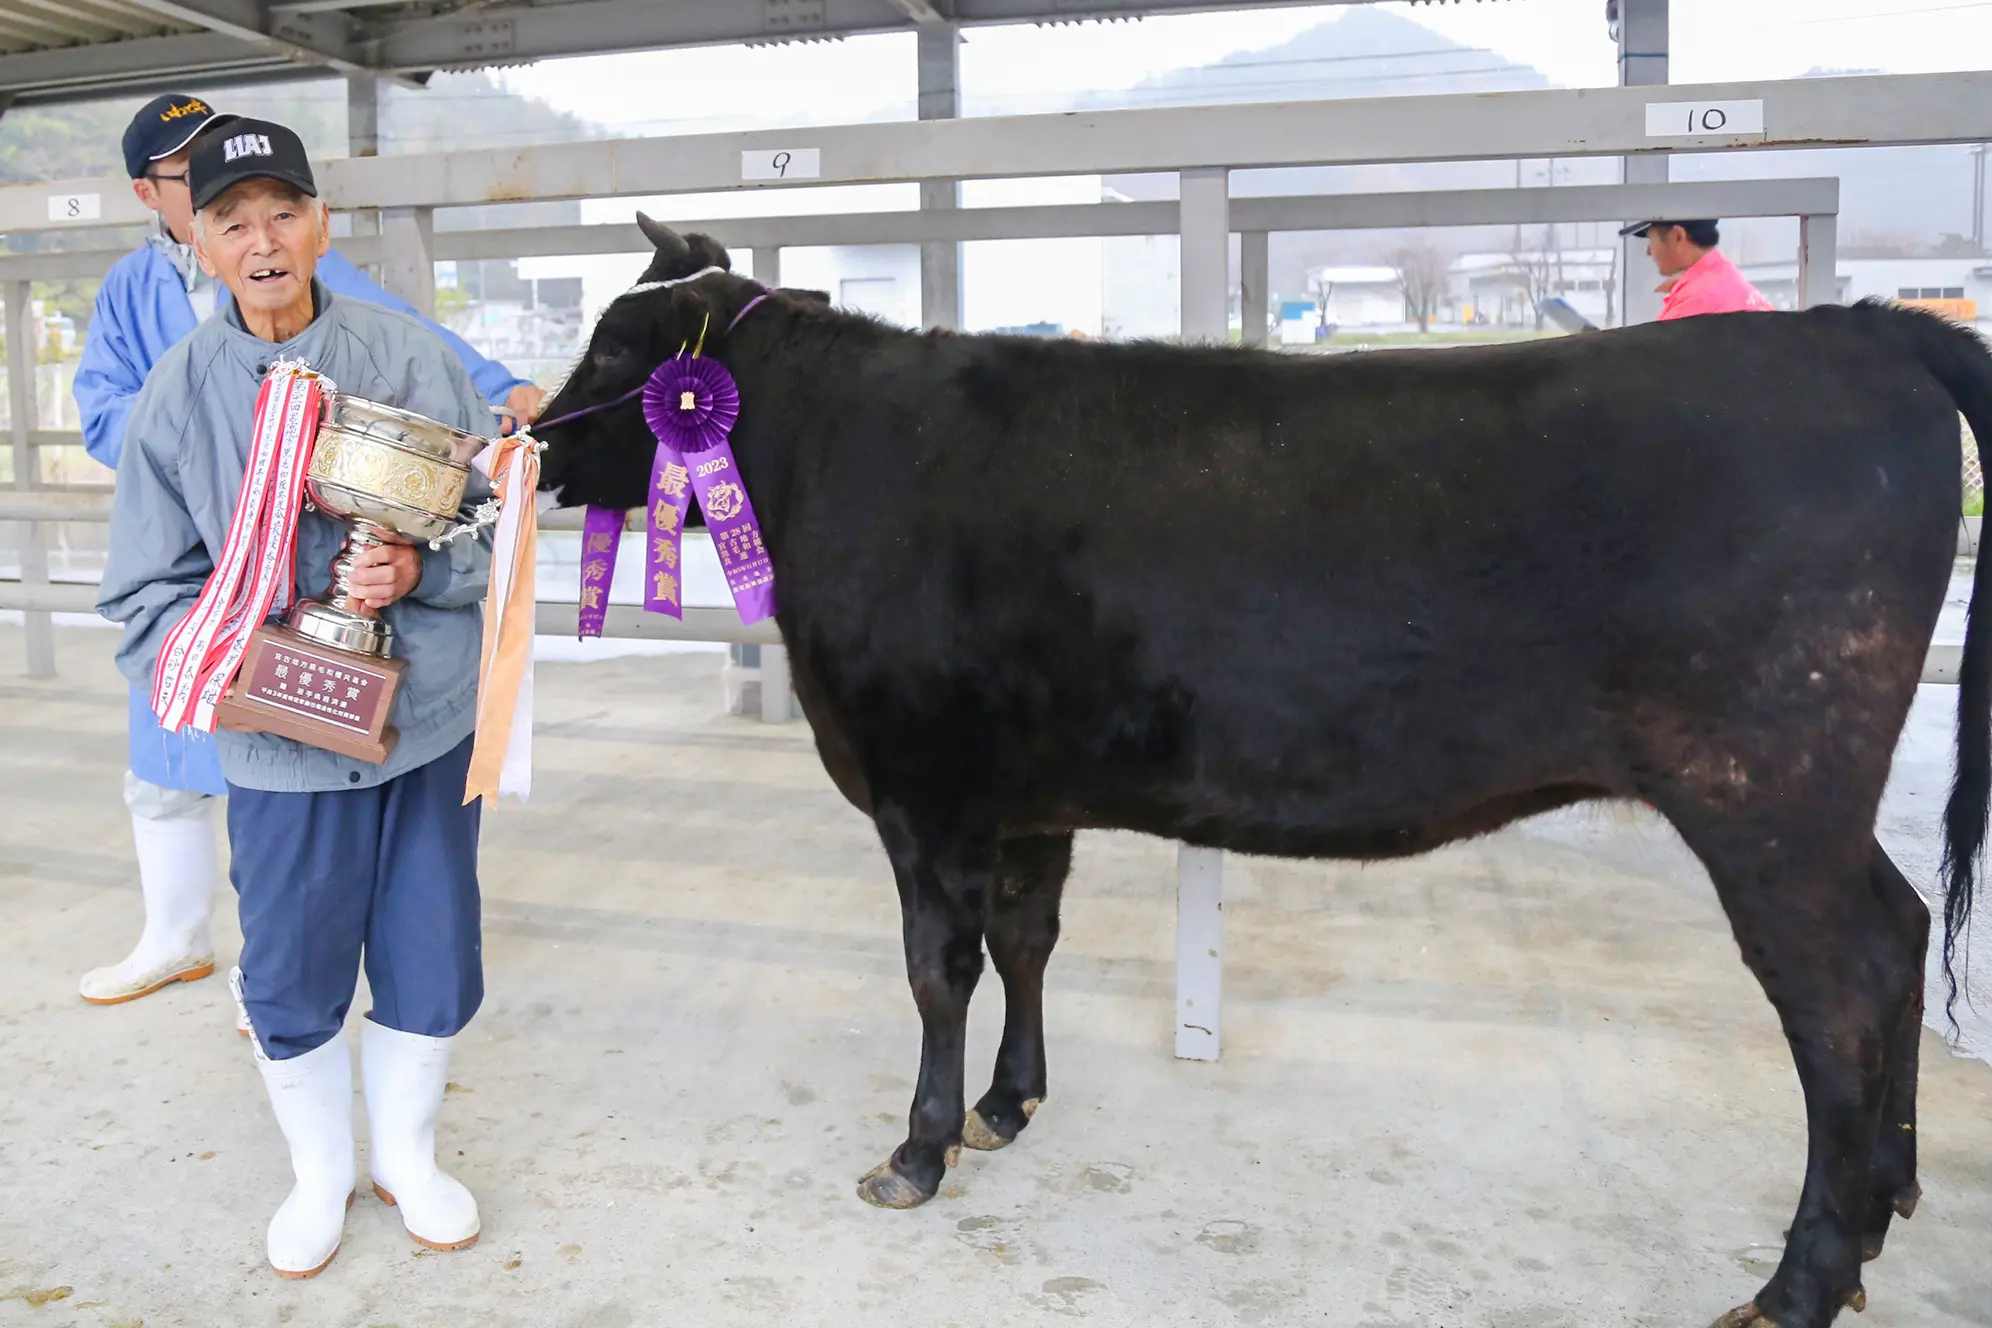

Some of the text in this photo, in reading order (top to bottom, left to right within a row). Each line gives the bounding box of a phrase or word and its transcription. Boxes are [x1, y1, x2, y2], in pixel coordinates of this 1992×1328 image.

[1688, 108, 1726, 133] 10
[772, 151, 792, 178] 9
[67, 198, 80, 217] 8
[696, 456, 729, 478] 2023
[652, 460, 690, 607] 最優秀賞
[273, 663, 361, 702] 最優秀賞
